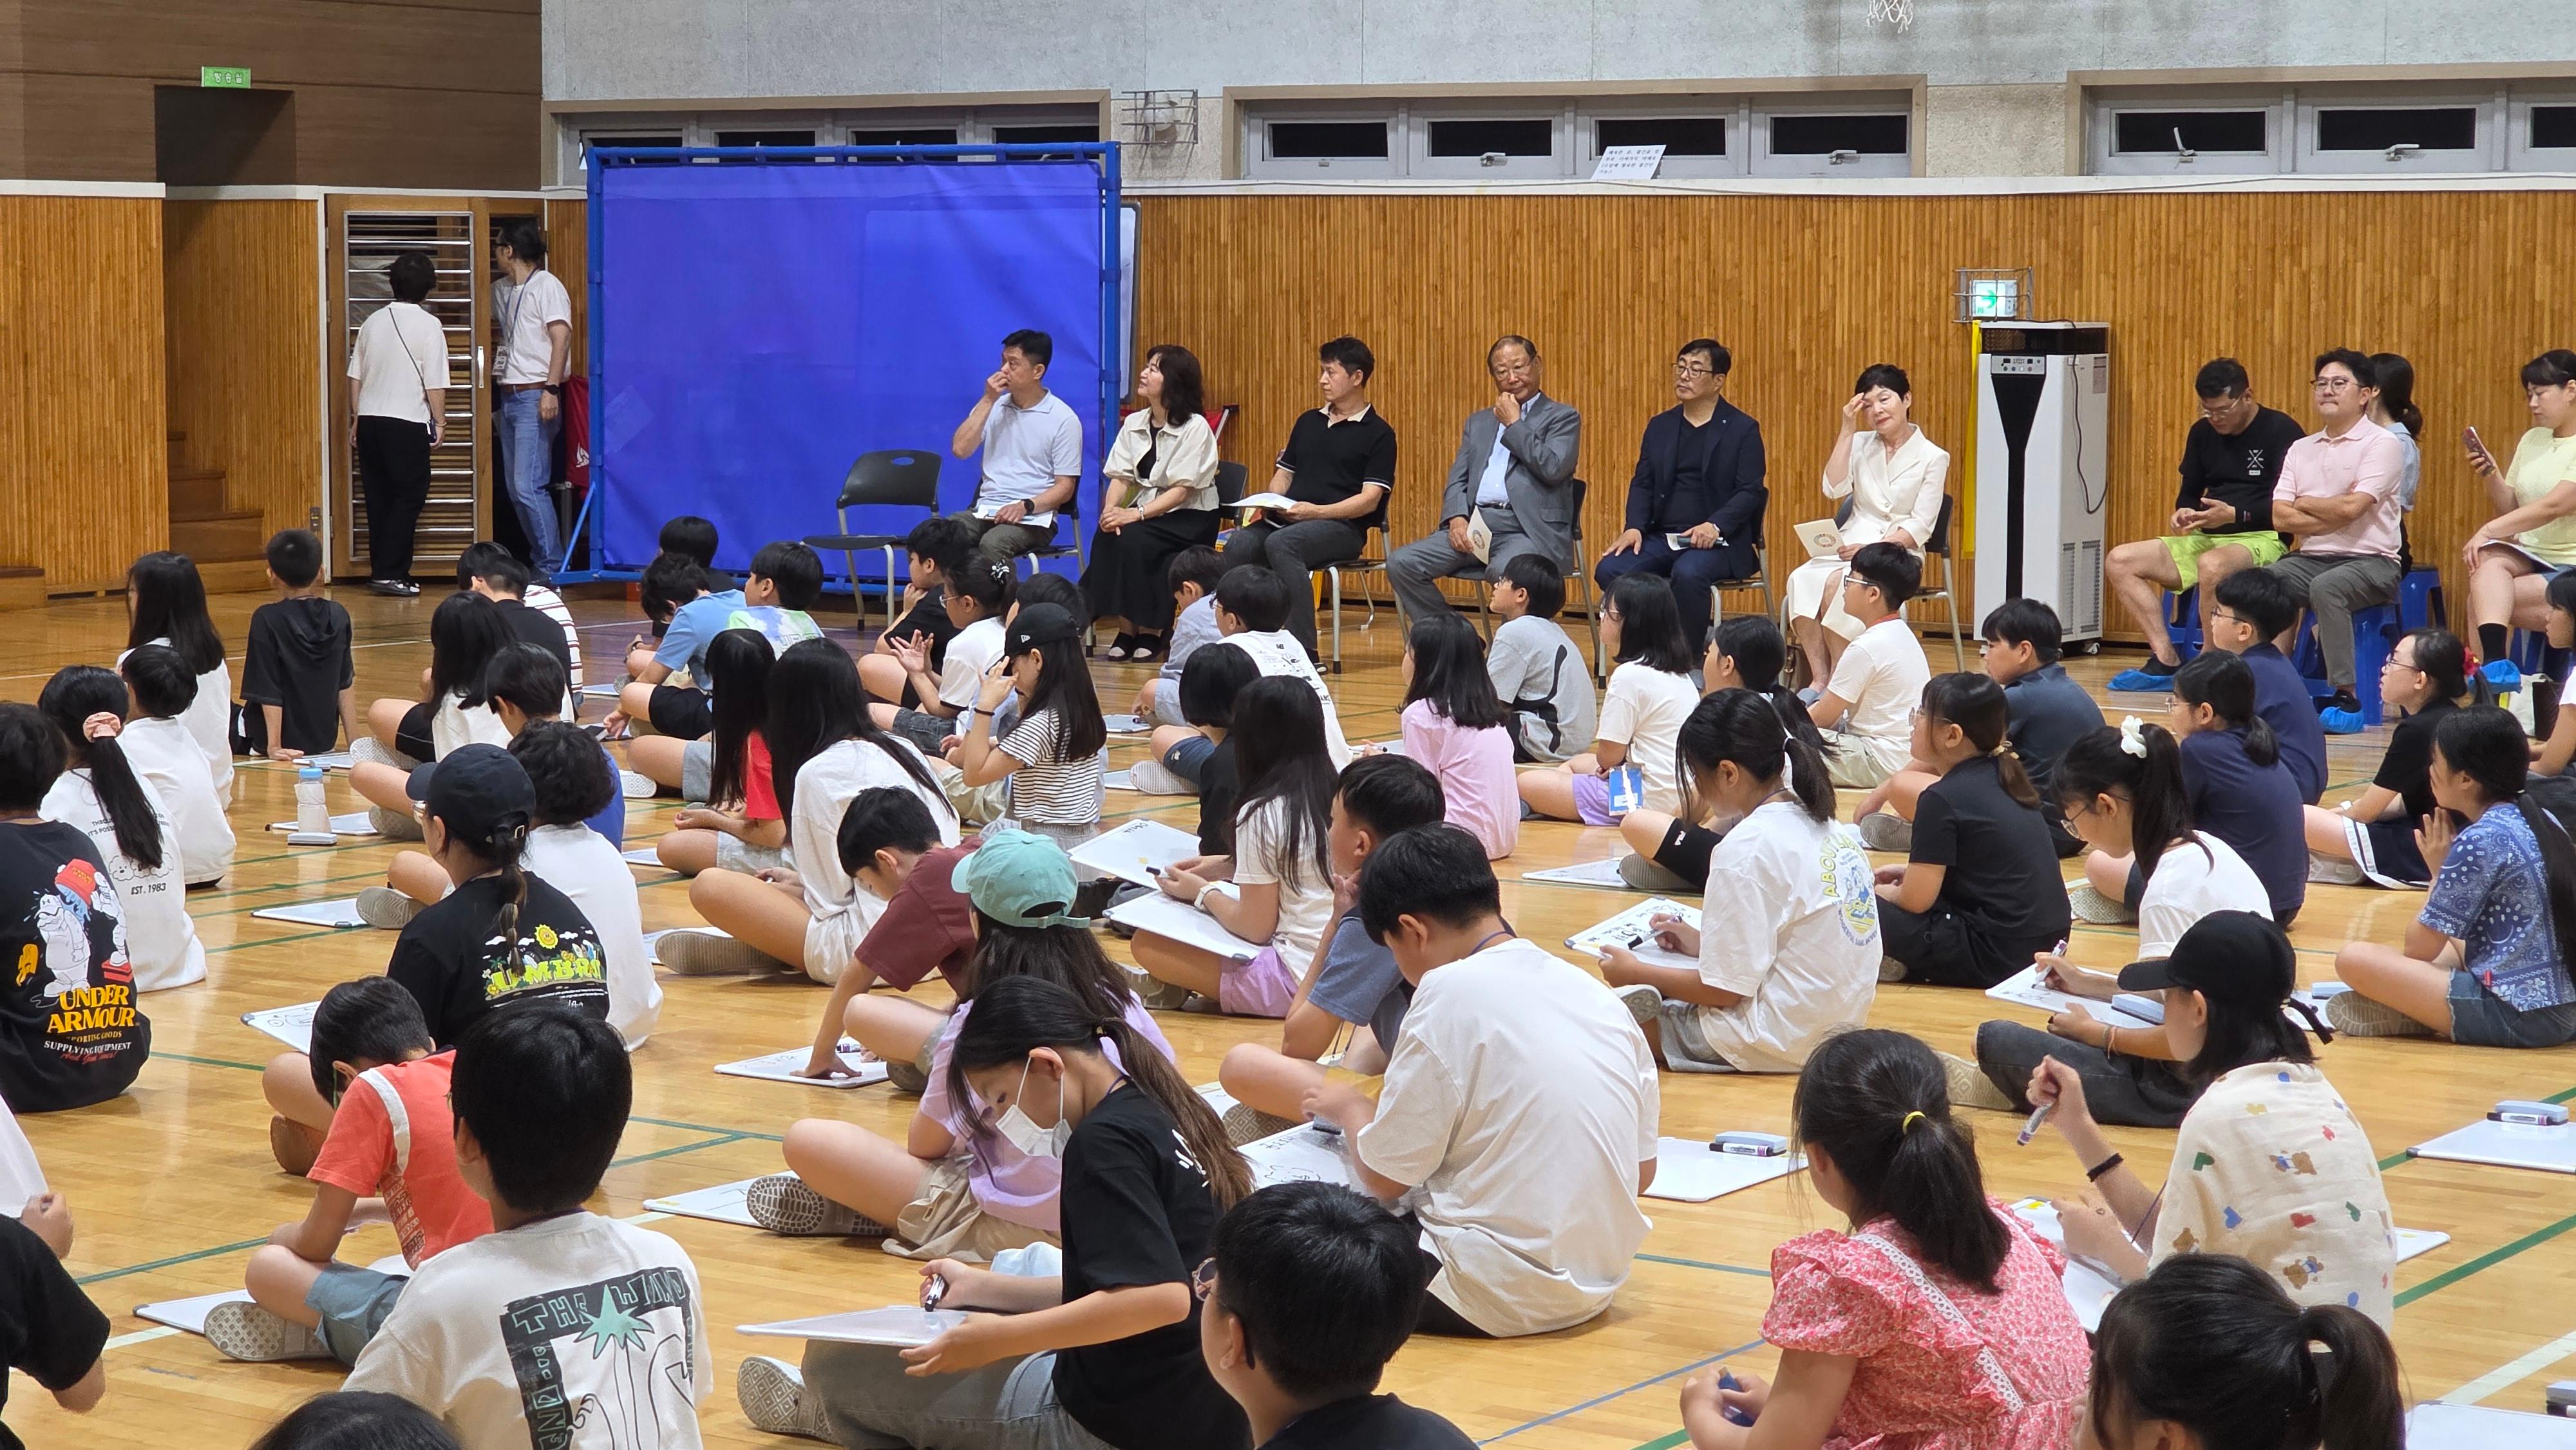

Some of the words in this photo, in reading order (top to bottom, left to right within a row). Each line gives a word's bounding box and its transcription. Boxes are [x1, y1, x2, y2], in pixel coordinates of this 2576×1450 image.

[214, 72, 242, 84] 방송실
[148, 882, 166, 894] 1983
[59, 984, 129, 1010] UNDER
[46, 1006, 135, 1033] ARMOUR
